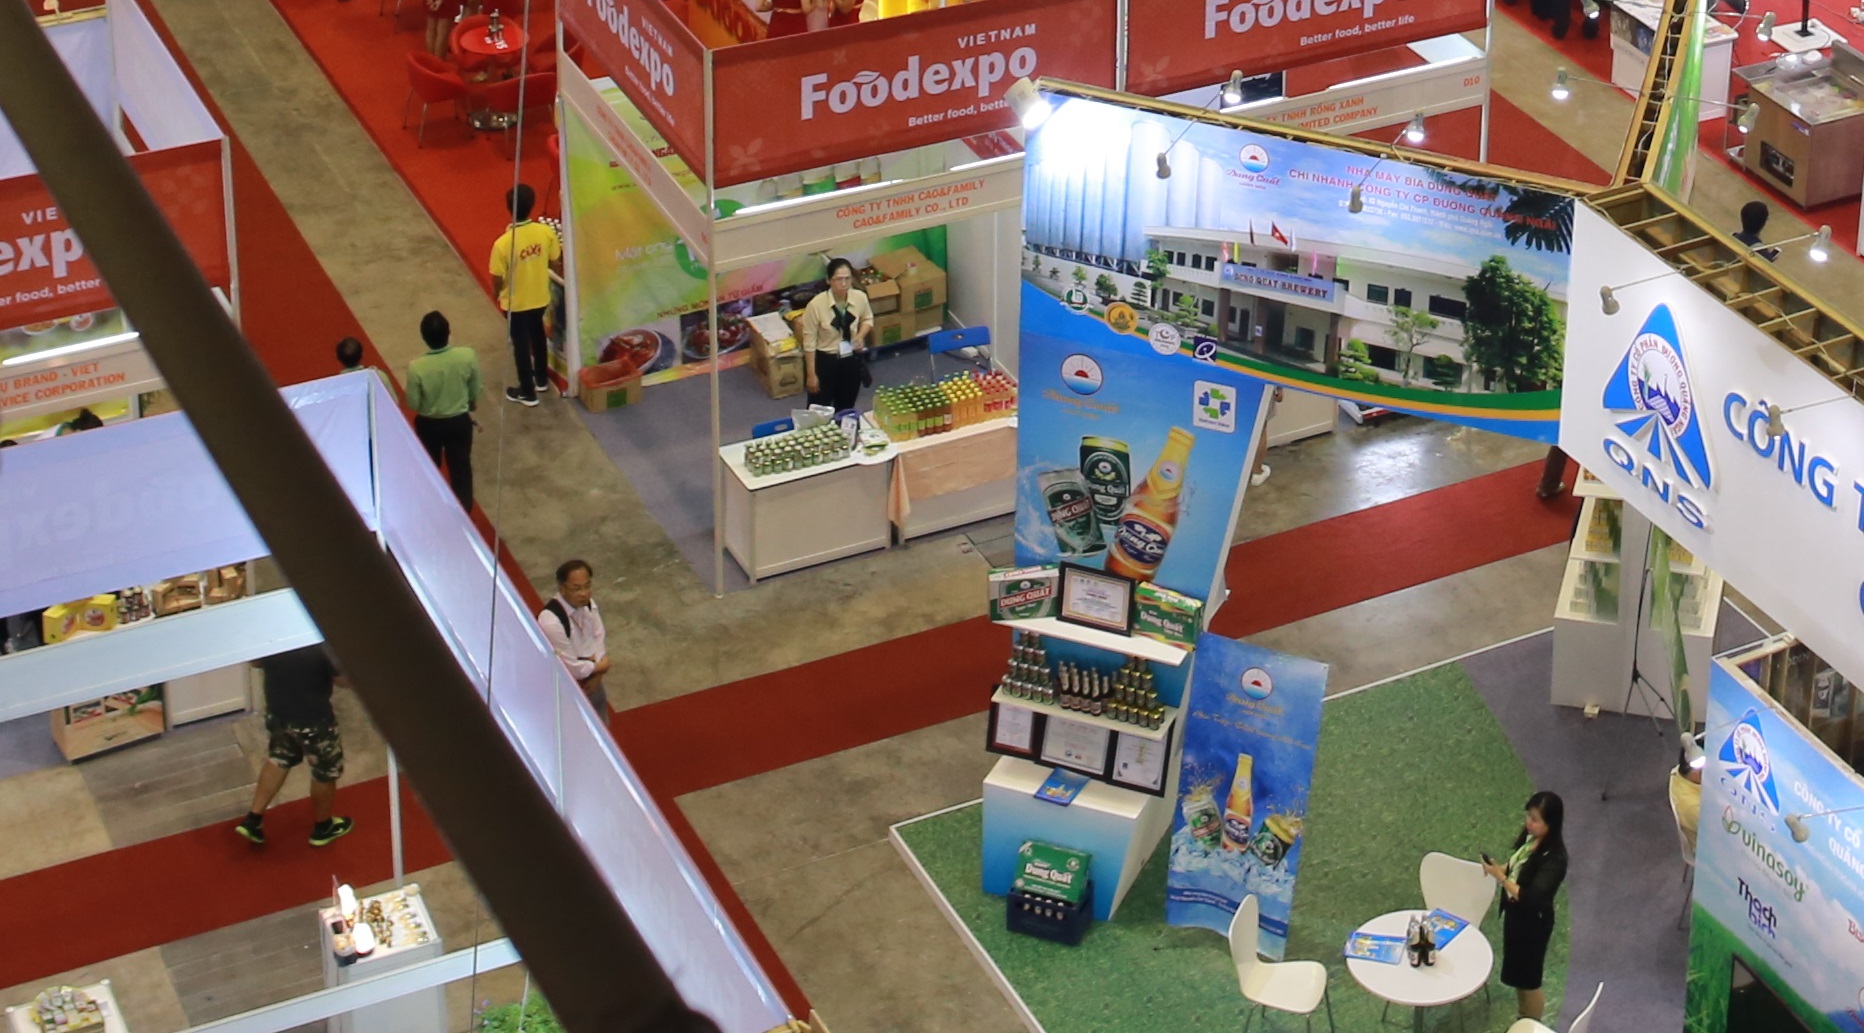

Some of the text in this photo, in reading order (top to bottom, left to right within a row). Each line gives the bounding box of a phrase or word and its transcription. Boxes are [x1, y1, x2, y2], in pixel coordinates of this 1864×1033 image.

[957, 23, 1037, 49] VIETNAM
[1299, 14, 1415, 47] Better food, better life
[800, 46, 1038, 121] Foodexpo
[1462, 74, 1481, 87] D10
[907, 98, 1010, 127] Better food, bette
[1278, 94, 1365, 125] TNHH RỒNG XANH
[1332, 106, 1379, 124] COMPANY
[835, 179, 986, 220] CÔNG TY TNHH CAO&FAMILY
[852, 207, 921, 229] CAO&FAMILY
[947, 196, 969, 209] LTD
[14, 277, 102, 304] food, better
[13, 362, 101, 391] BRAND VIET
[34, 372, 126, 401] CORPORATION
[1723, 391, 1838, 509] CÔNG
[1602, 437, 1712, 531] QNS
[1792, 780, 1826, 818] CÔNG
[1843, 823, 1862, 850] CỔ
[1024, 862, 1049, 879] Dung
